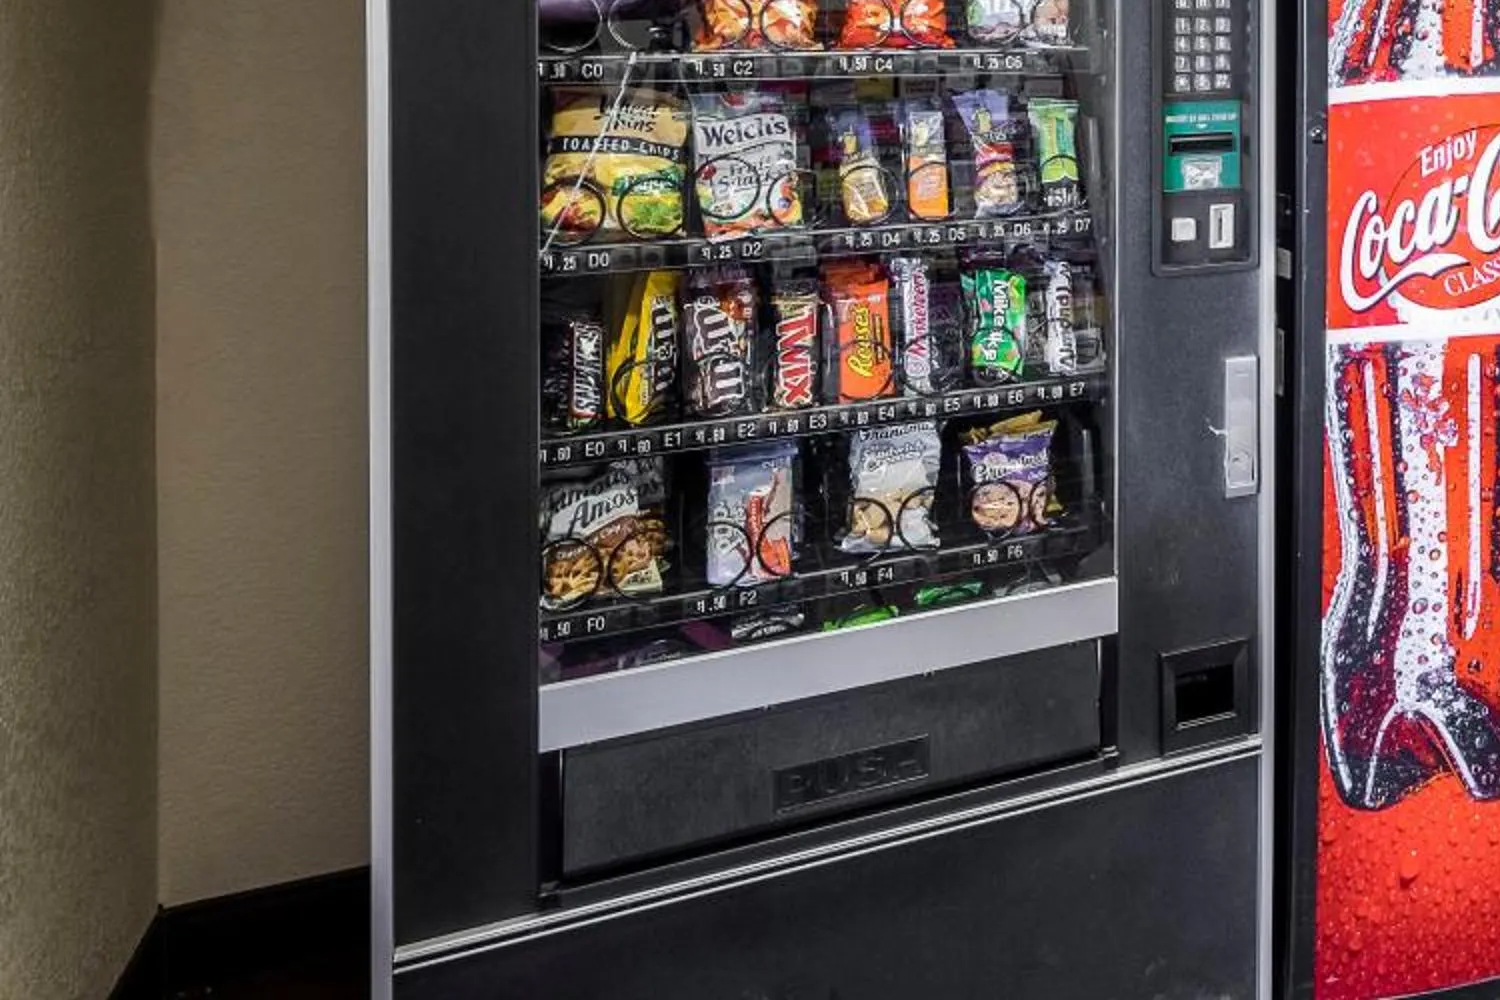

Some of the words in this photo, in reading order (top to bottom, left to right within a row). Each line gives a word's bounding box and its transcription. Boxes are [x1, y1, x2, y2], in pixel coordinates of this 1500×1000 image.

[580, 62, 604, 78] C0
[733, 60, 754, 76] C2
[874, 56, 894, 71] C4
[1004, 55, 1024, 70] C6
[701, 114, 788, 148] Welch's
[562, 136, 630, 152] TOASTED
[1419, 130, 1478, 178] Enjoy
[948, 226, 967, 242] D5
[1013, 221, 1032, 236] D6
[1075, 218, 1091, 233] D7
[881, 231, 901, 248] D4
[741, 241, 763, 258] D2
[587, 252, 610, 269] D0
[992, 278, 1009, 327] Mike
[1055, 295, 1075, 369] Almond
[1006, 389, 1024, 405] E6
[1069, 382, 1086, 398] E7
[943, 397, 961, 413] E5
[808, 413, 828, 430] E3
[877, 406, 895, 422] E4
[663, 431, 682, 448] E1
[737, 423, 756, 440] E2
[584, 440, 606, 458] E0
[566, 487, 638, 539] Amos
[1006, 544, 1024, 561] F6
[876, 566, 894, 582] F4
[738, 590, 758, 608] F2
[586, 616, 606, 634] F0
